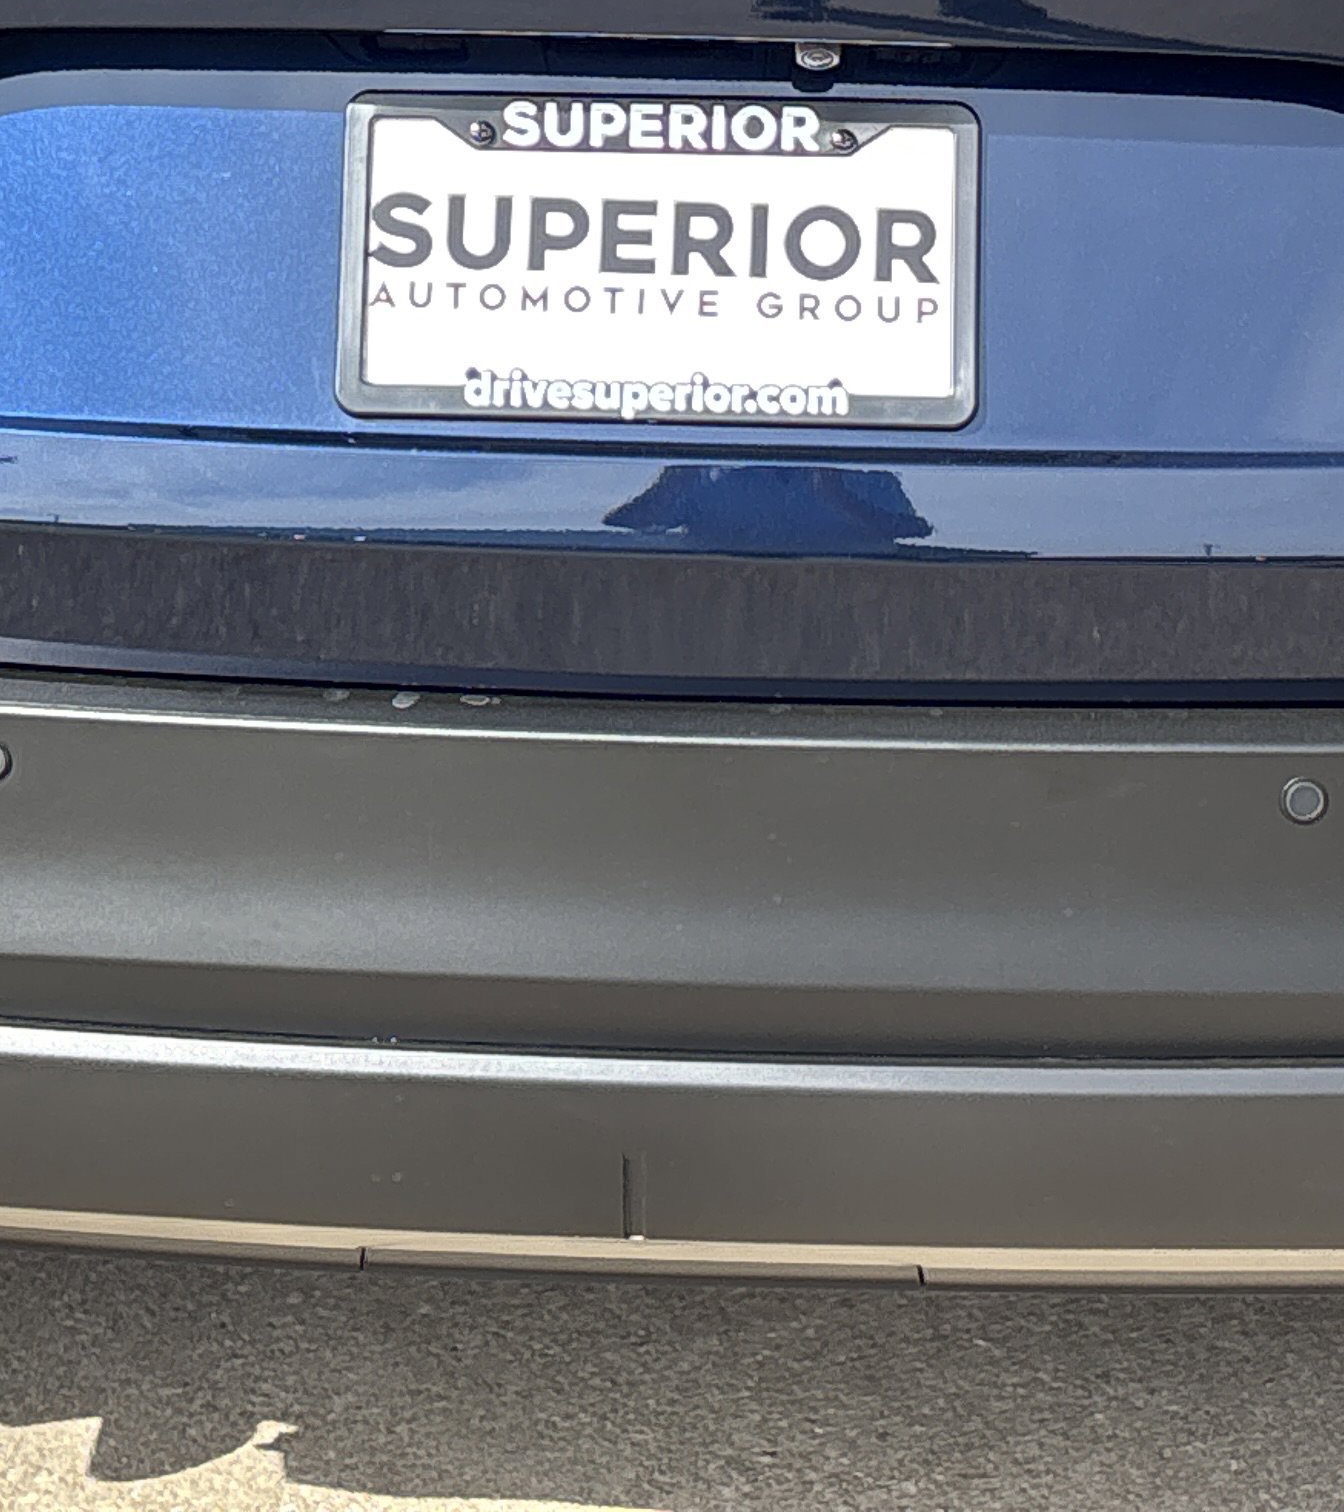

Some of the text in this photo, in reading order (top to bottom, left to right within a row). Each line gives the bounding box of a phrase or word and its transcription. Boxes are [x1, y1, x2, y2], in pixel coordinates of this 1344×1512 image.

[501, 99, 821, 153] SUPERIOR
[368, 191, 940, 285] SUPERIOR
[369, 281, 939, 324] AUTOMOTIVE GROUP
[464, 369, 850, 419] drivesuperior.com
